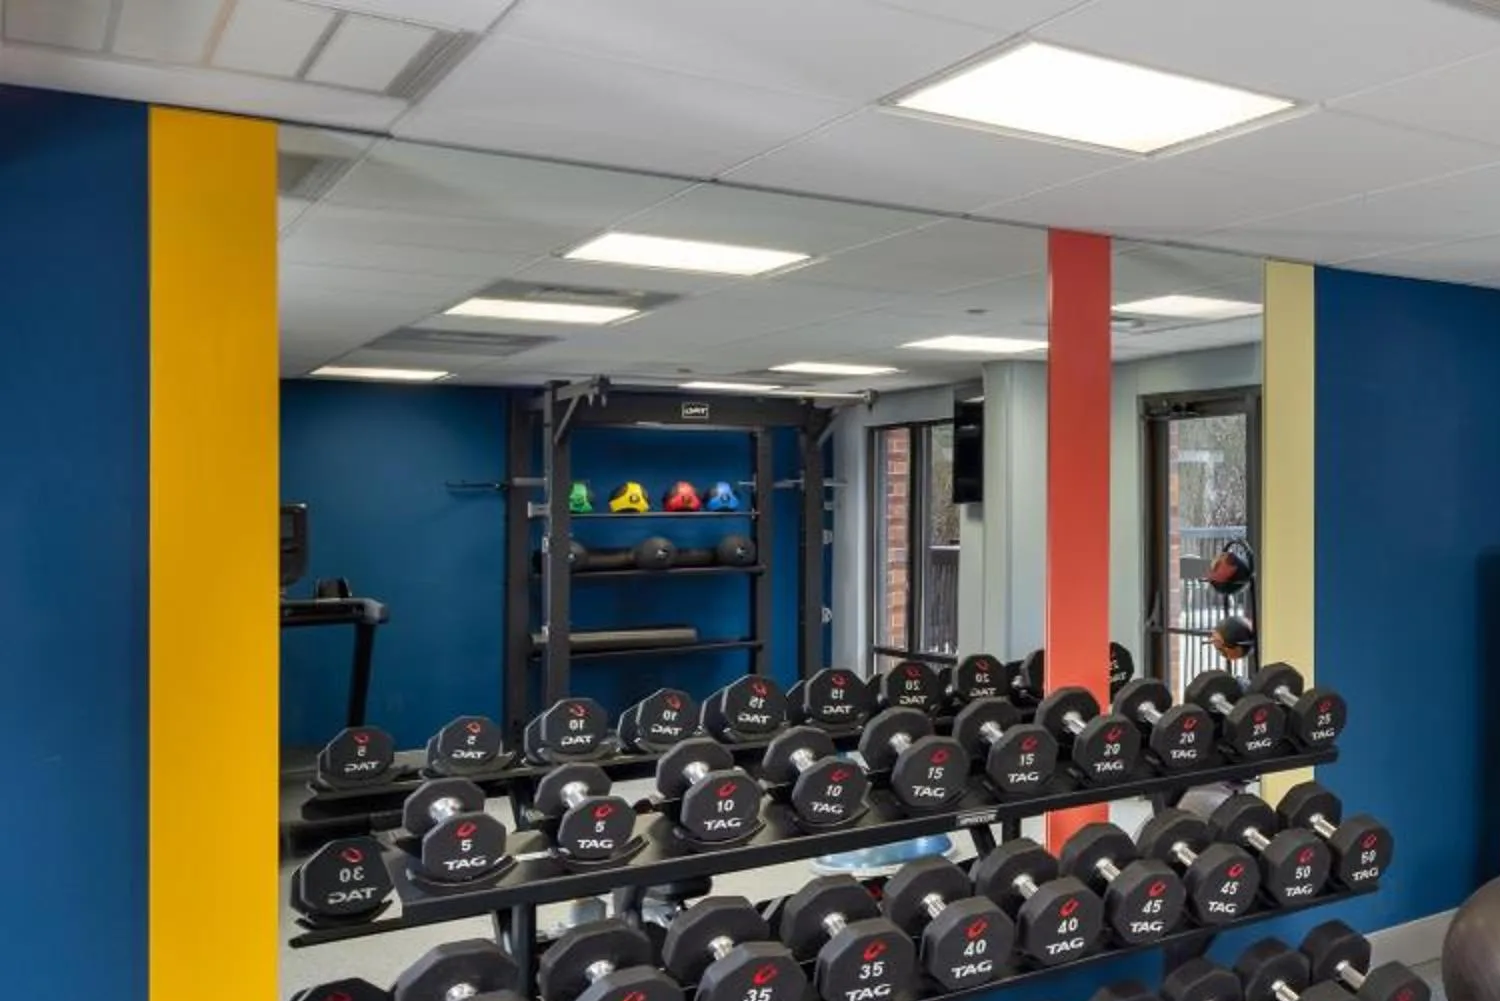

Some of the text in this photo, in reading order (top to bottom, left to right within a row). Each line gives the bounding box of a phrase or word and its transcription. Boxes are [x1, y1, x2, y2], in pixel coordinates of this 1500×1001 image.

[1317, 713, 1331, 727] 25
[1179, 731, 1195, 745] 20
[1311, 727, 1335, 741] TAG
[1103, 742, 1121, 757] 20
[1245, 737, 1272, 751] TAG
[1020, 752, 1035, 766] 15
[1170, 749, 1197, 759] TAG
[927, 766, 945, 780] 15
[1093, 759, 1124, 773] TAG
[1007, 771, 1039, 784] TAG
[826, 784, 843, 797] 10
[911, 785, 945, 799] TAG
[717, 799, 735, 813] 10
[811, 801, 843, 815] TAG
[594, 820, 606, 833] 5
[703, 817, 742, 831] TAG
[461, 839, 472, 852] 5
[577, 839, 614, 849] TAG
[443, 855, 487, 871] TAG
[1295, 865, 1312, 880] 50
[1351, 867, 1379, 881] TAG
[1220, 881, 1239, 895] 45
[1285, 883, 1313, 897] TAG
[1141, 899, 1163, 914] 45
[1208, 900, 1237, 914] TAG
[1057, 917, 1079, 934] 40
[1130, 920, 1163, 933] TAG
[963, 939, 987, 957] 40
[1046, 937, 1085, 955] TAG
[859, 961, 885, 980] 35
[951, 959, 993, 979] TAG
